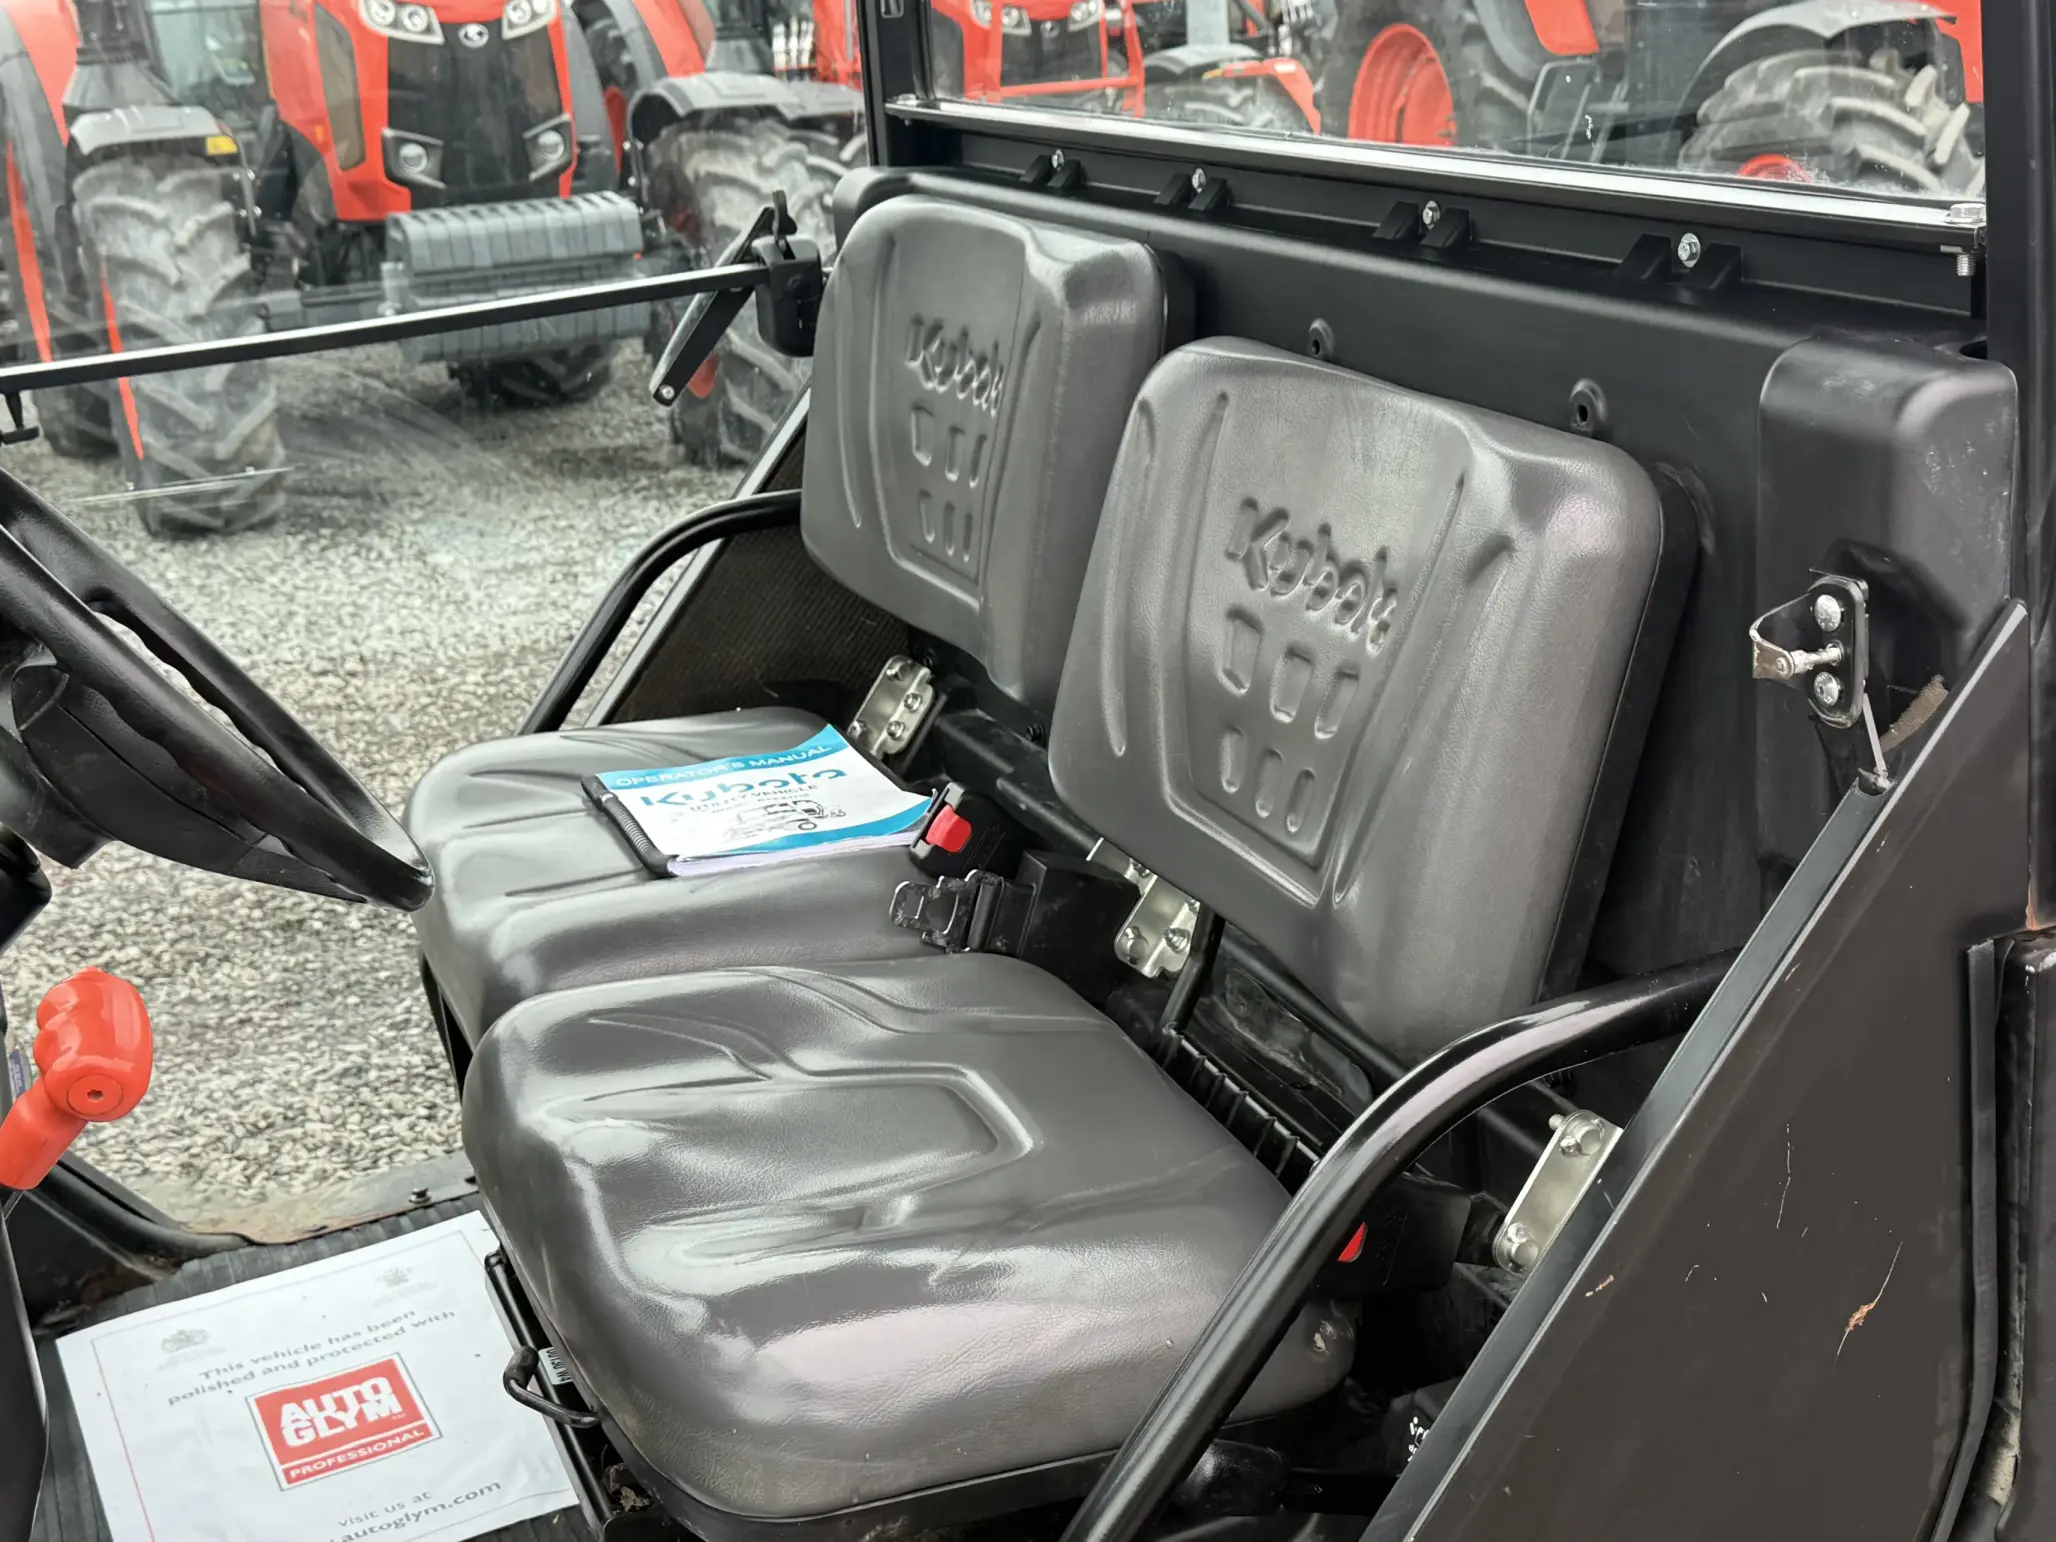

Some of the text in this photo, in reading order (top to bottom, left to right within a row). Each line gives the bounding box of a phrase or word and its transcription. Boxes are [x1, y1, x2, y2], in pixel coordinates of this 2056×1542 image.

[905, 312, 1003, 419] Kubota
[1224, 496, 1397, 654] Kubota
[615, 744, 832, 786] OPERATOR'S MANUAL
[640, 767, 848, 808] Kubota
[750, 784, 818, 799] VEHICLE
[167, 1370, 257, 1406] polished
[262, 1358, 303, 1380] and
[307, 1326, 408, 1368] protected
[411, 1309, 456, 1333] with
[198, 1361, 244, 1382] This
[250, 1339, 322, 1367] vehicle
[328, 1327, 361, 1347] has
[365, 1310, 416, 1335] been
[279, 1376, 393, 1428] AUTO
[280, 1391, 404, 1448] GLYM
[288, 1428, 426, 1481] PROFESSIONAL
[337, 1490, 432, 1528] visit us at
